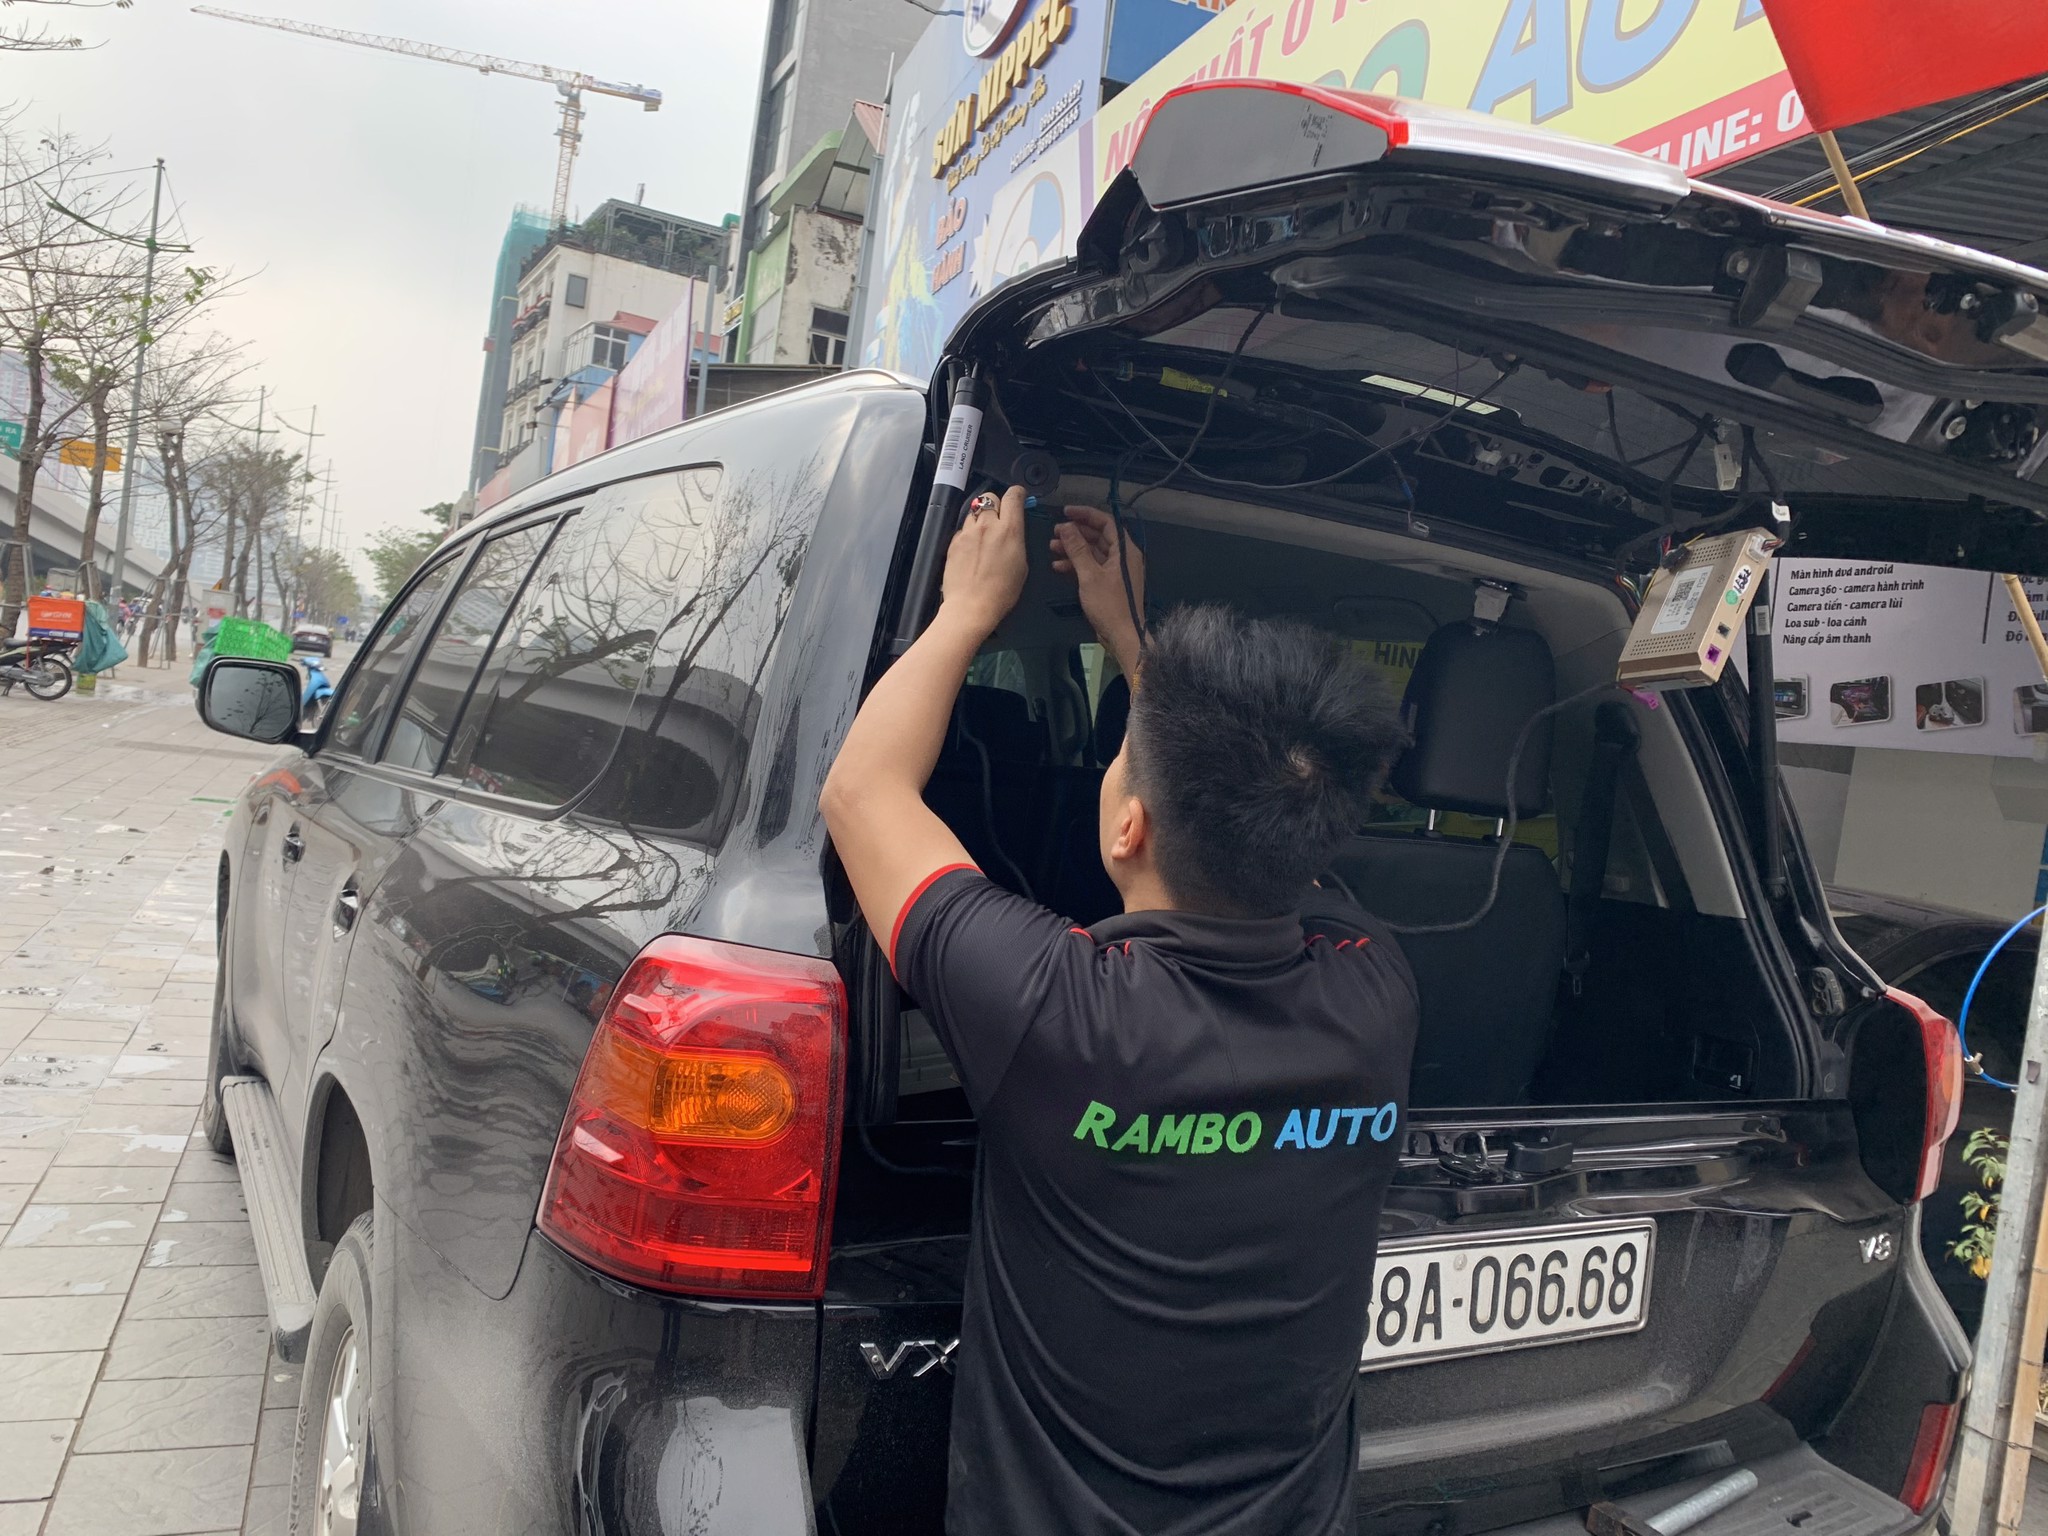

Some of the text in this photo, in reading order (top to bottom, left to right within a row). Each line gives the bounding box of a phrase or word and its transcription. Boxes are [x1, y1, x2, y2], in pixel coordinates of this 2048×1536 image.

[1466, 0, 1766, 124] AU
[1790, 564, 1894, 579] Màn hình dvd android
[1789, 586, 1819, 596] Camera
[1820, 585, 1837, 597] 360
[1843, 583, 1875, 593] camera
[1877, 580, 1899, 592] hành
[1901, 579, 1924, 591] trình
[1787, 602, 1822, 612] Camera
[1824, 598, 1842, 610] tiến
[1850, 599, 1887, 610] camera
[1889, 597, 1903, 608] lùi
[1785, 619, 1801, 628] Loa
[1803, 617, 1820, 627] sub
[1827, 616, 1842, 627] loa
[1843, 616, 1867, 627] cánh
[1783, 634, 1806, 646] Nâng
[1825, 634, 1841, 644] âm
[1843, 632, 1871, 643] thanh
[1373, 641, 1426, 670] HIN
[1074, 1100, 1398, 1155] RAMBO AUTO
[1859, 1232, 1891, 1264] V8
[1366, 1242, 1637, 1347] 8A-066.68
[860, 1339, 960, 1380] VX
